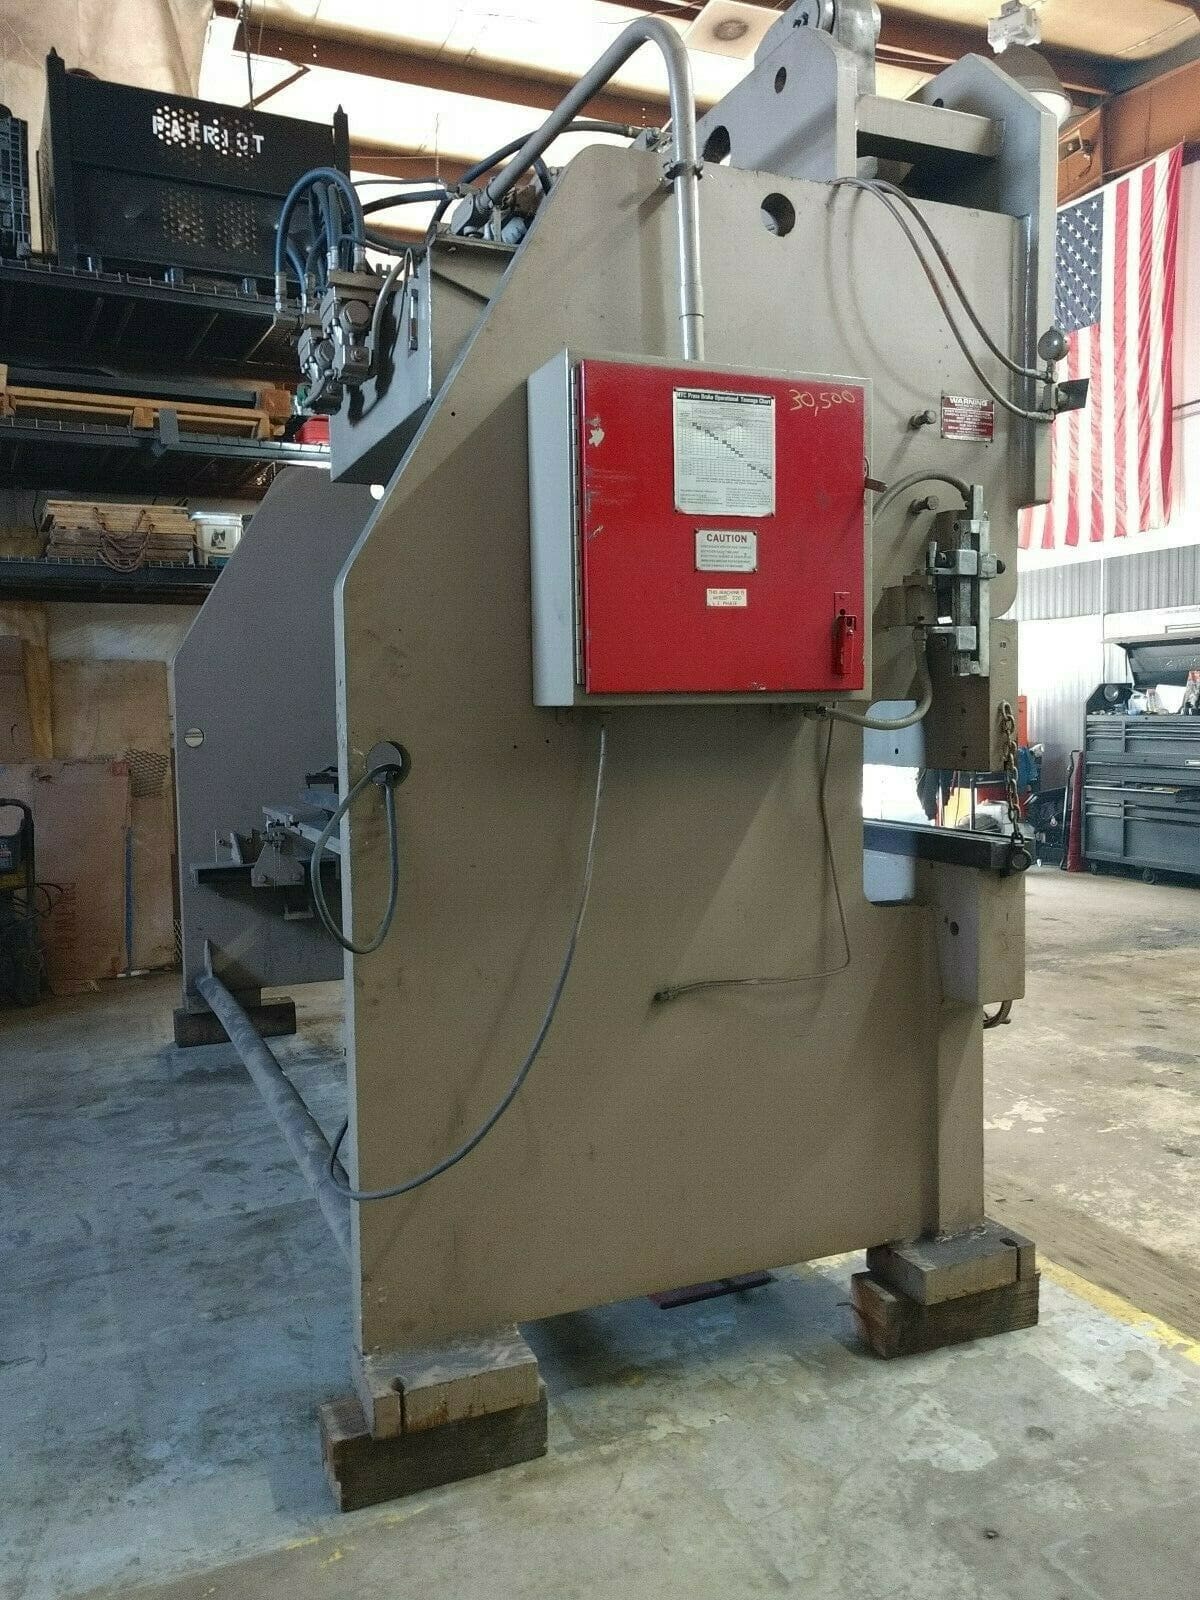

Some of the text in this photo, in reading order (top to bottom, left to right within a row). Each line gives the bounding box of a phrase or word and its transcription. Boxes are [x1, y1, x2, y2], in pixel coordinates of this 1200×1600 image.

[152, 115, 265, 154] PATRIOT
[788, 389, 855, 417] 30,500
[950, 397, 989, 406] WARNING
[706, 534, 747, 542] CAUTION
